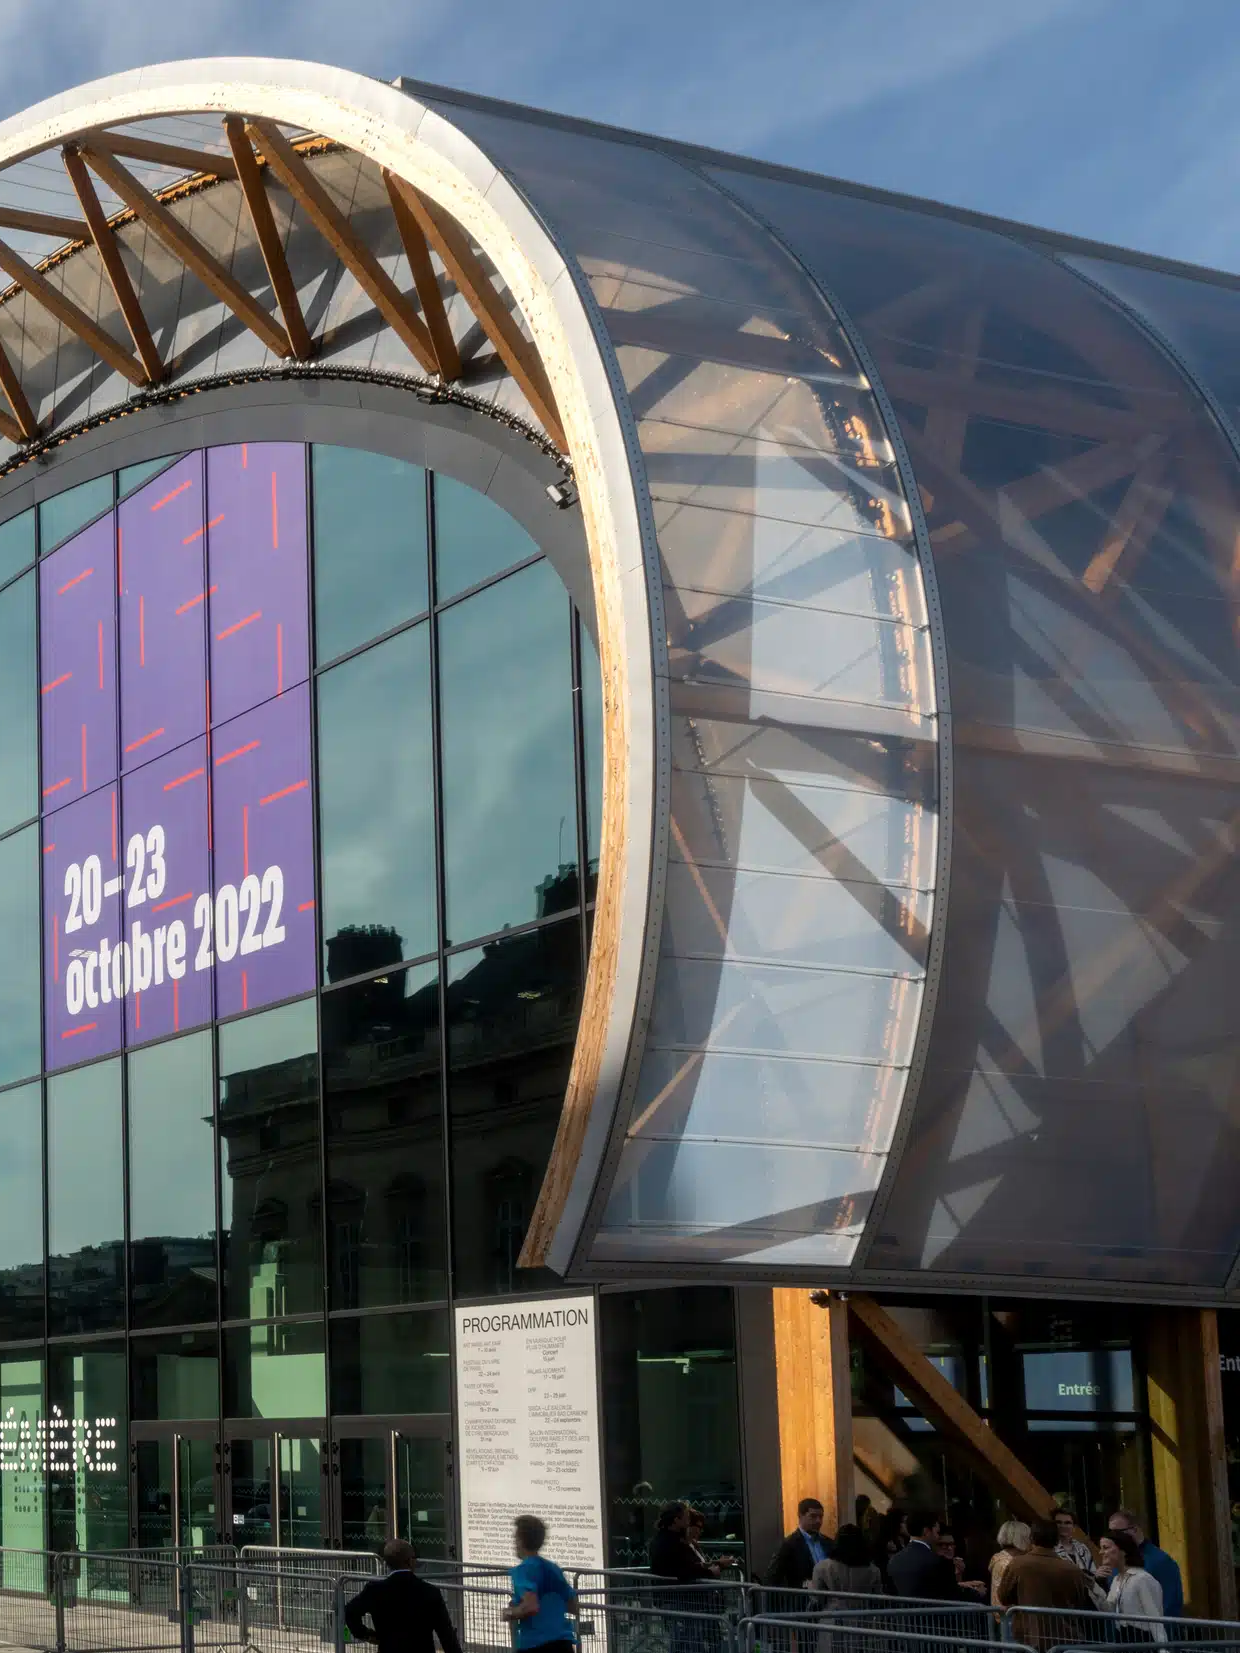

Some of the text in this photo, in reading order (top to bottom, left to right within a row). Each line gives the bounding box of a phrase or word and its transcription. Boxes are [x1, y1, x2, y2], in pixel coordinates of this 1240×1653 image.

[66, 865, 286, 1015] octobre 2022
[462, 1308, 589, 1335] PROGRAMMATION
[1058, 1382, 1100, 1396] Entrée
